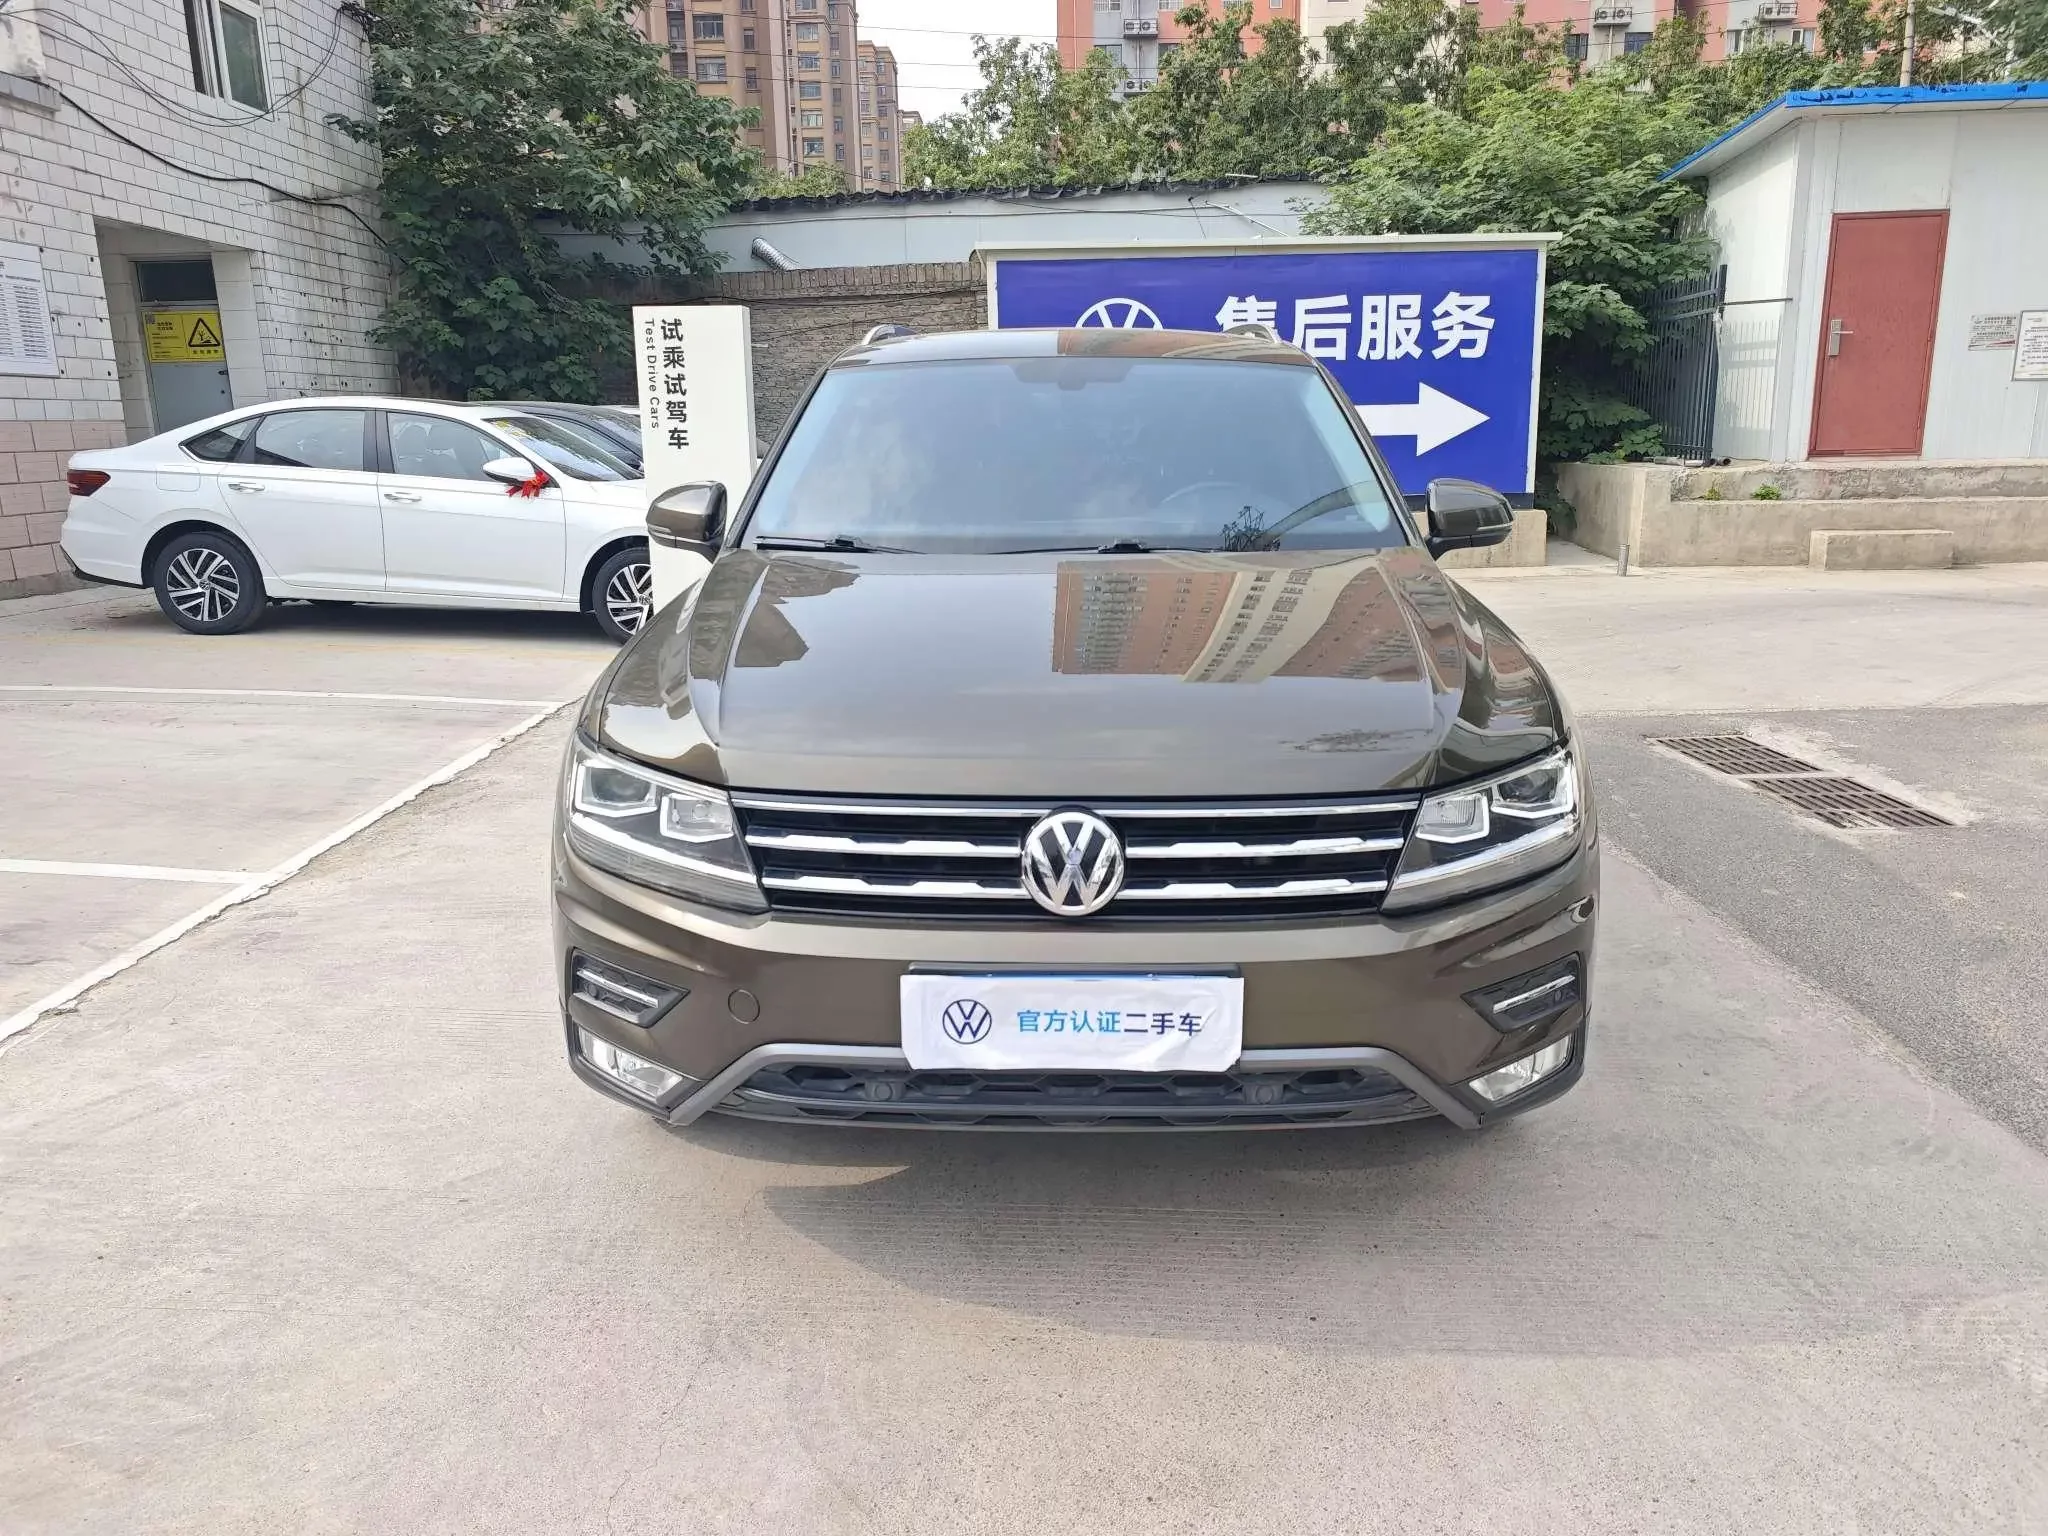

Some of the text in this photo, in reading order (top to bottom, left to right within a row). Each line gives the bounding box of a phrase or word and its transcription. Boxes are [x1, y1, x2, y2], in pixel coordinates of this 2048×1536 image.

[1215, 291, 1495, 361] 售后服务
[645, 318, 660, 429] Test Drive Cars
[661, 318, 689, 450] 试乘试驾车
[1025, 814, 1122, 913] VW
[943, 999, 992, 1043] VW
[1016, 1009, 1203, 1037] 官方认证二手车
